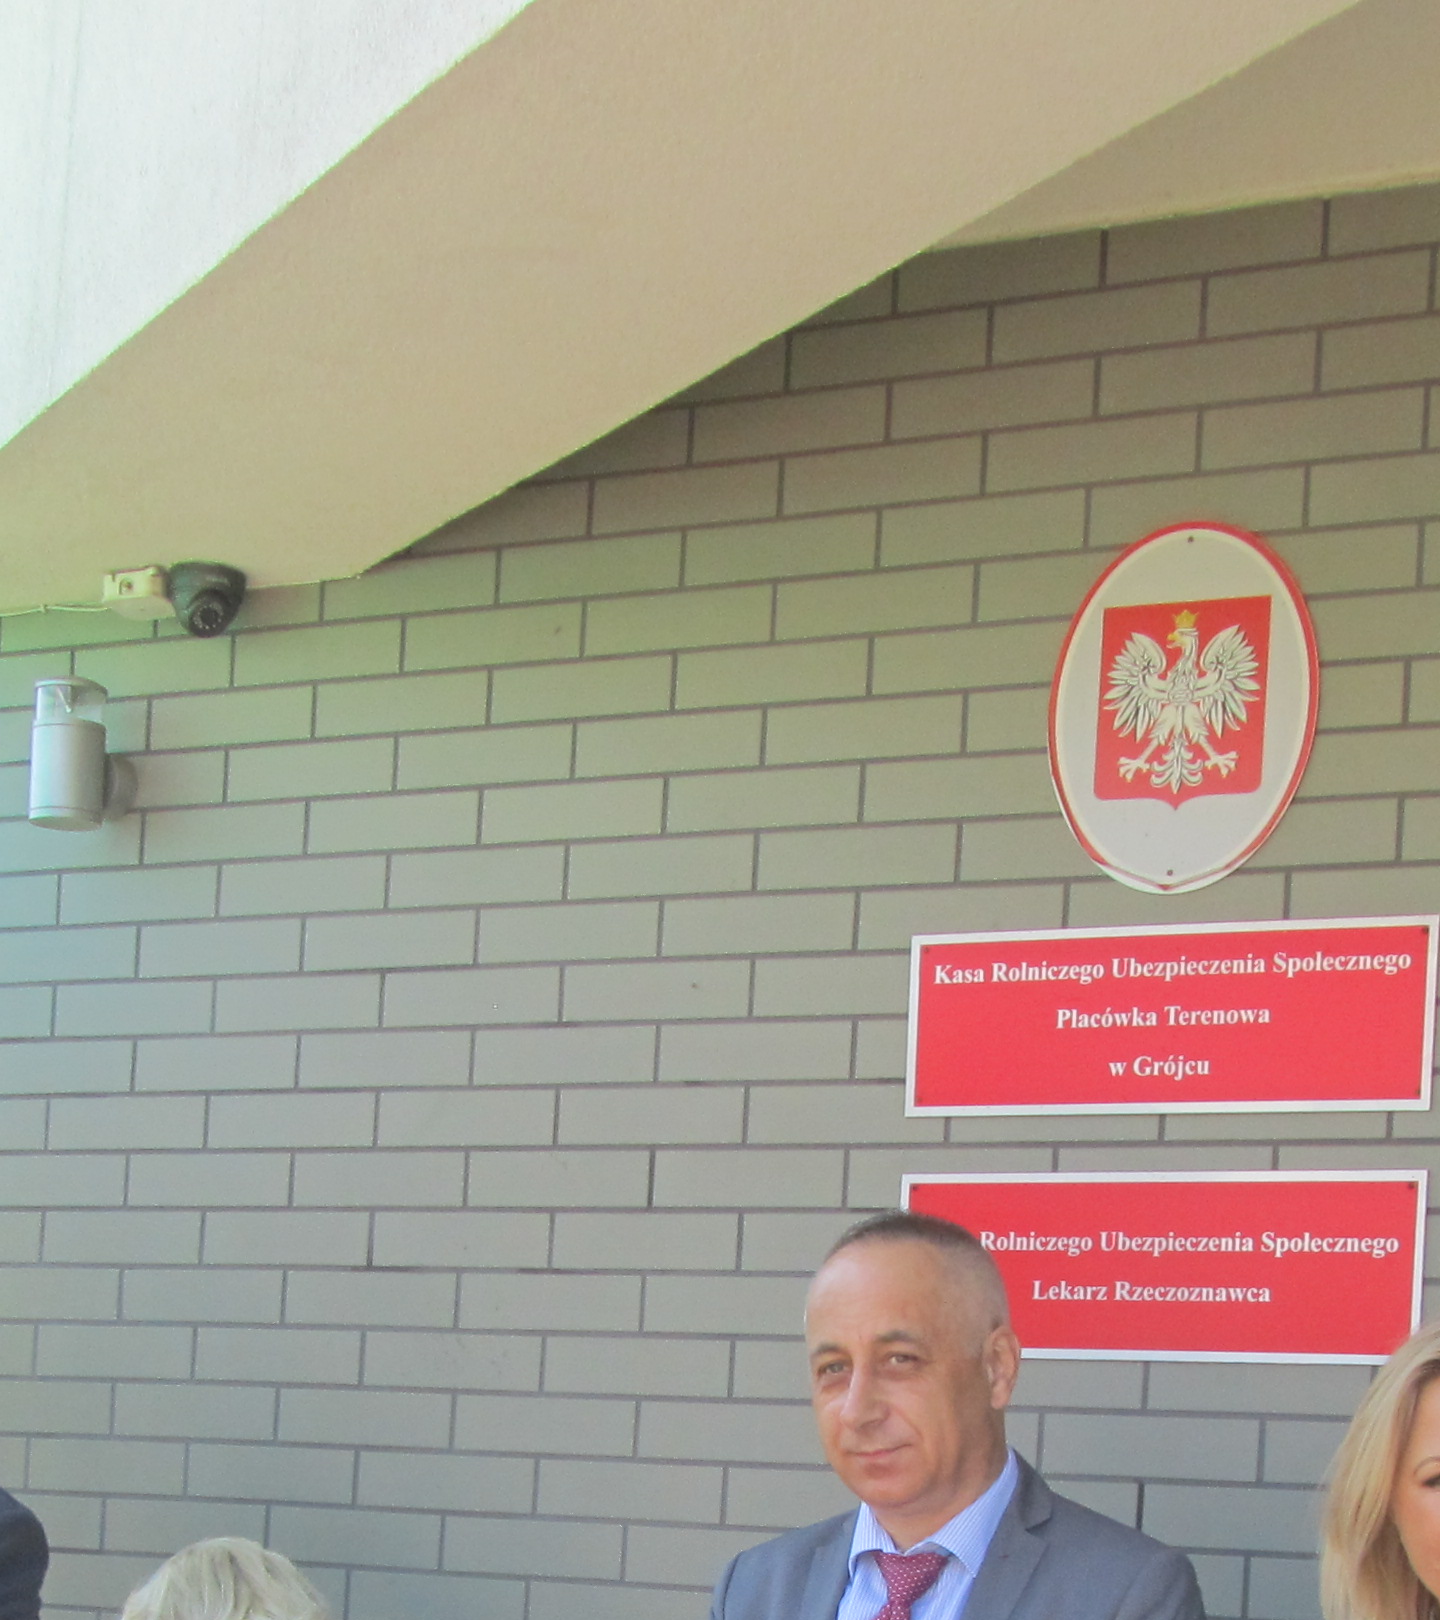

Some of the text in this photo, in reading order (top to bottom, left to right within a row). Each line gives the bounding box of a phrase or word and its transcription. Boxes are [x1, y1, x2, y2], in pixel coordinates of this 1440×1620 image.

[933, 950, 1412, 985] Kasa Rolniczego Ubezpieczenia Społecznego
[1055, 1005, 1271, 1030] Placówka Terenowa
[1108, 1054, 1210, 1082] w Grójcu
[979, 1231, 1400, 1259] Rolniczego Ubezpieczenia Społecznego
[1031, 1279, 1271, 1303] Lekarz Rzeczoznawca
